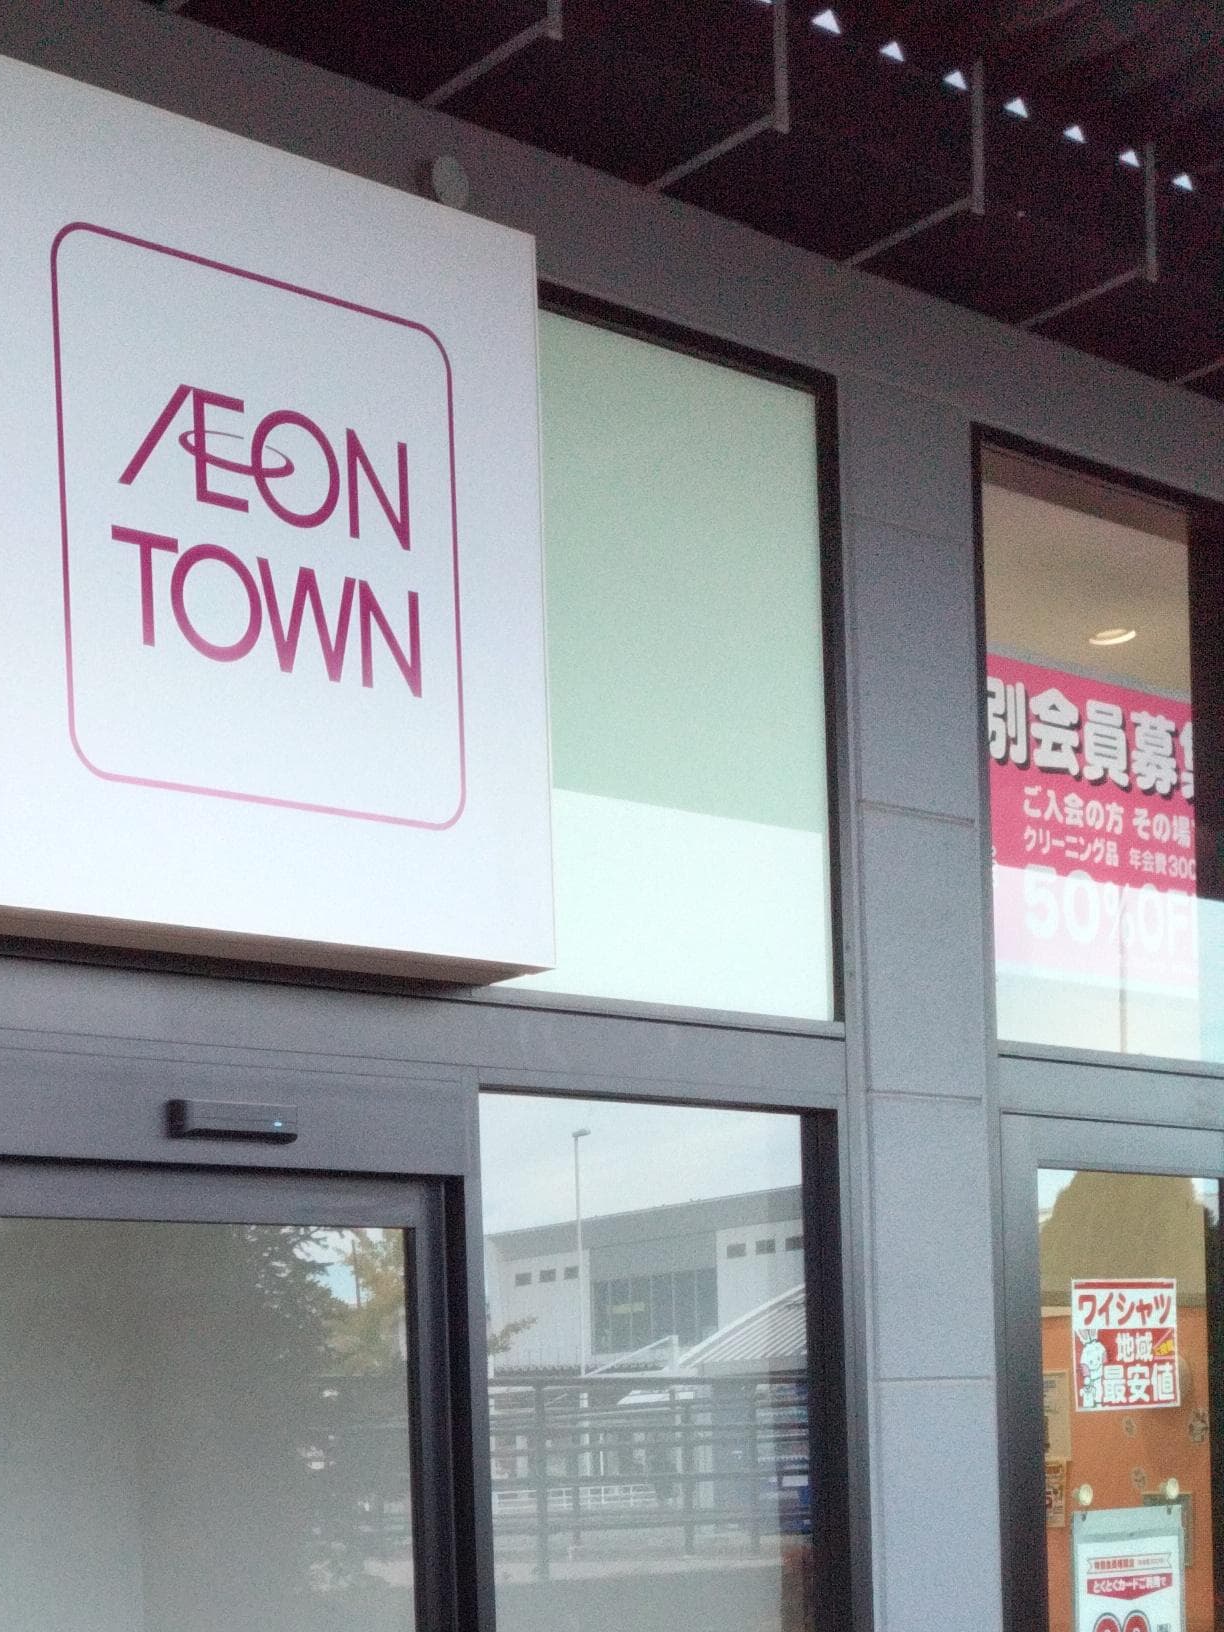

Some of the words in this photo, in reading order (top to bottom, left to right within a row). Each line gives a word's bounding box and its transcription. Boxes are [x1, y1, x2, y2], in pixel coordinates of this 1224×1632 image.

[111, 524, 423, 698] TOWN
[987, 676, 1194, 799] 別会員募
[1023, 785, 1124, 835] ご入会の方
[1132, 807, 1196, 848] その場
[1023, 825, 1119, 868] クリーニング品
[1078, 1292, 1172, 1326] ワイシャツ
[1115, 1332, 1153, 1362] 地域
[1103, 1363, 1175, 1404] 最安値
